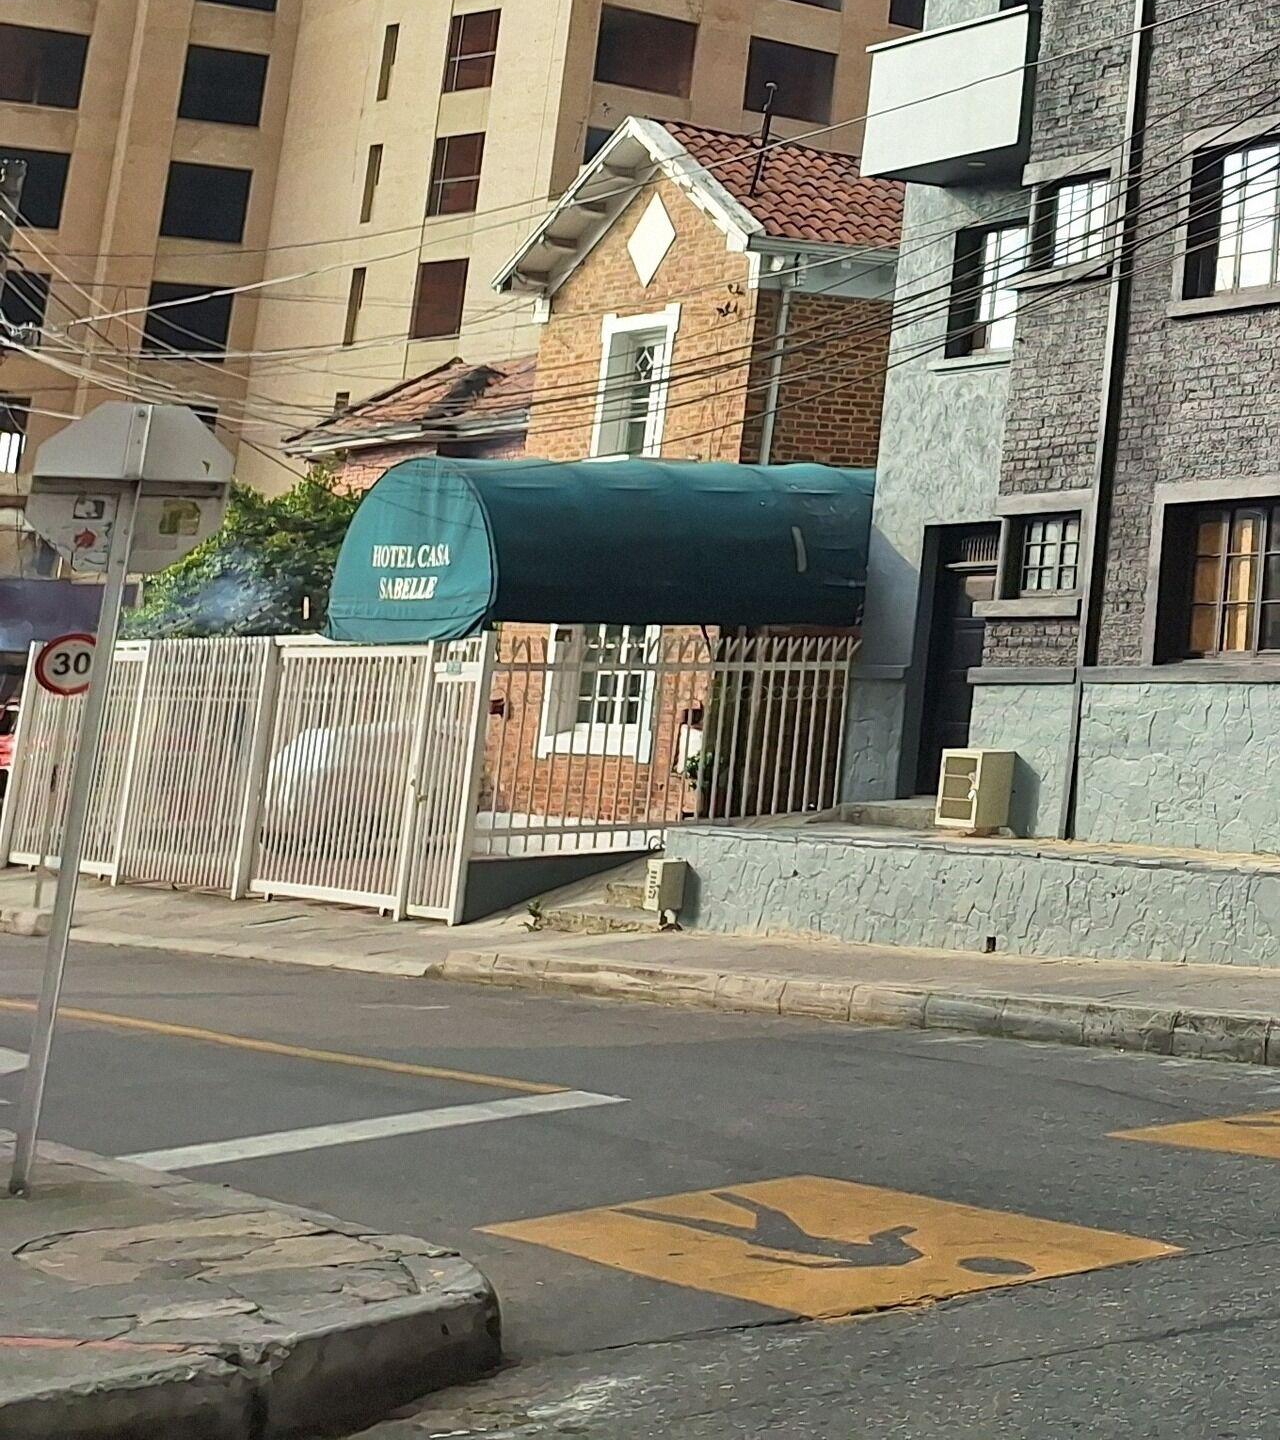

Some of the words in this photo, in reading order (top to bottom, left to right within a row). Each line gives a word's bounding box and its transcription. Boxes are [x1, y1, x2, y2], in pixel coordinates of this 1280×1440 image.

[372, 544, 415, 568] HOTEL
[417, 543, 451, 568] CASA
[379, 576, 438, 600] SABELLE
[52, 651, 92, 676] 30
